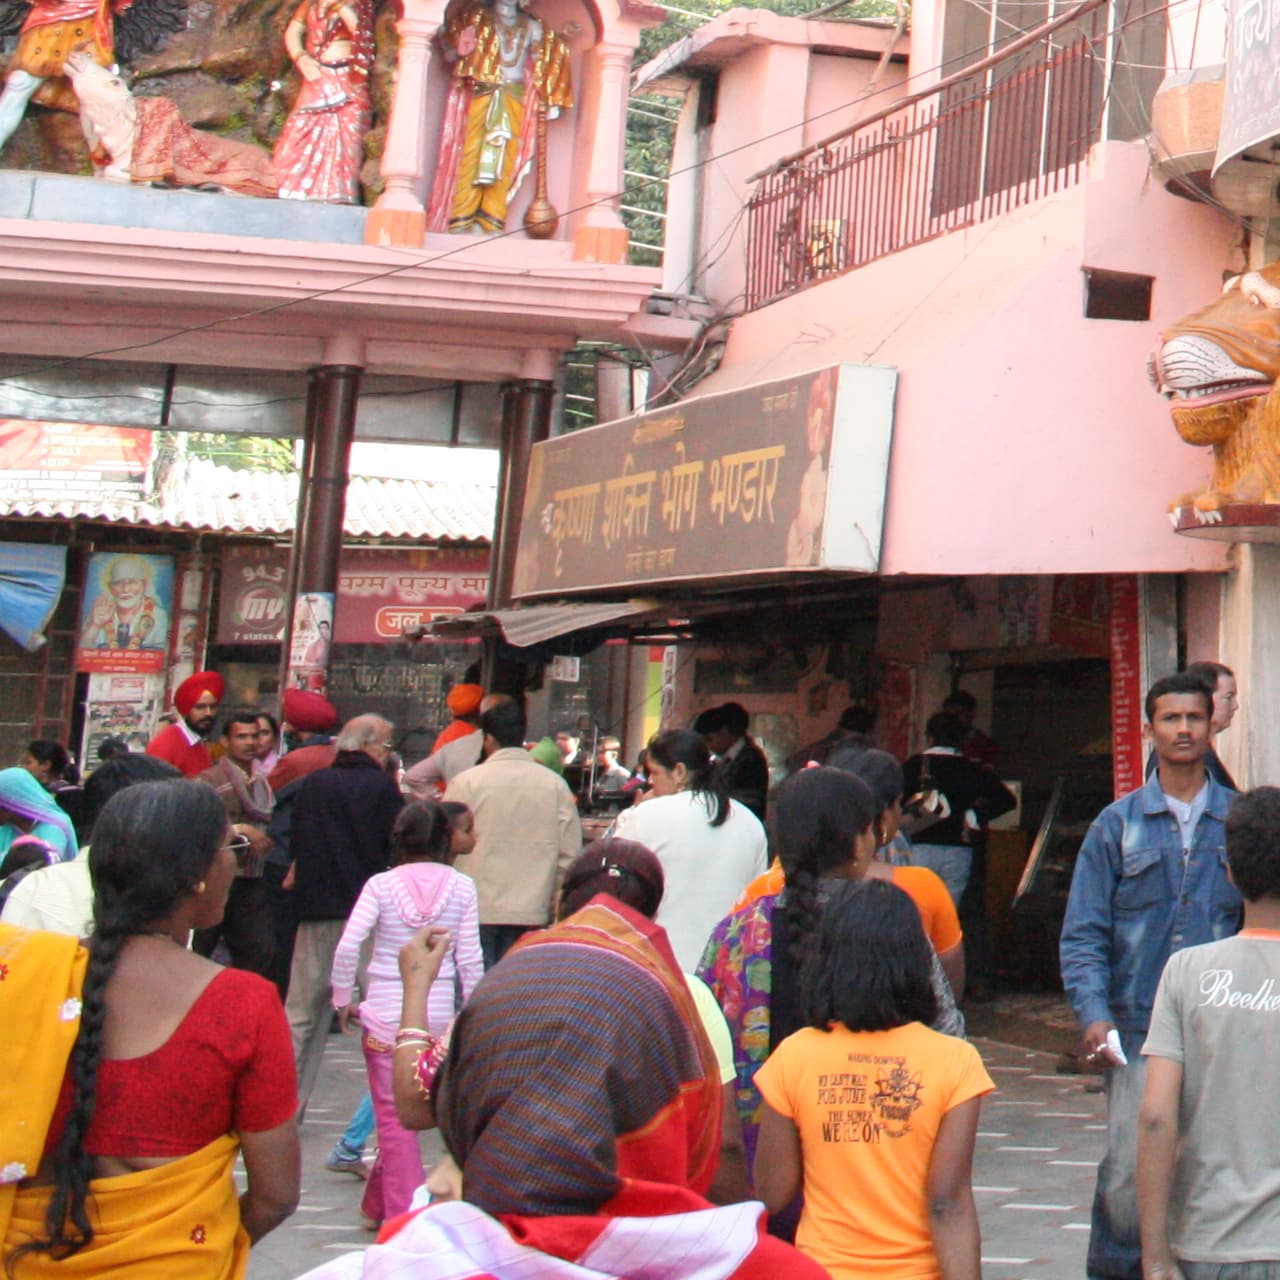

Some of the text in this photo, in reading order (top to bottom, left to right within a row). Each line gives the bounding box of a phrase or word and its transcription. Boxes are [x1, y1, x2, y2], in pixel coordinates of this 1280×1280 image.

[603, 453, 657, 550] शक्ति
[661, 441, 705, 534] भोग
[710, 445, 786, 525] भण्डार
[339, 575, 389, 591] परम
[862, 1121, 881, 1144] ON
